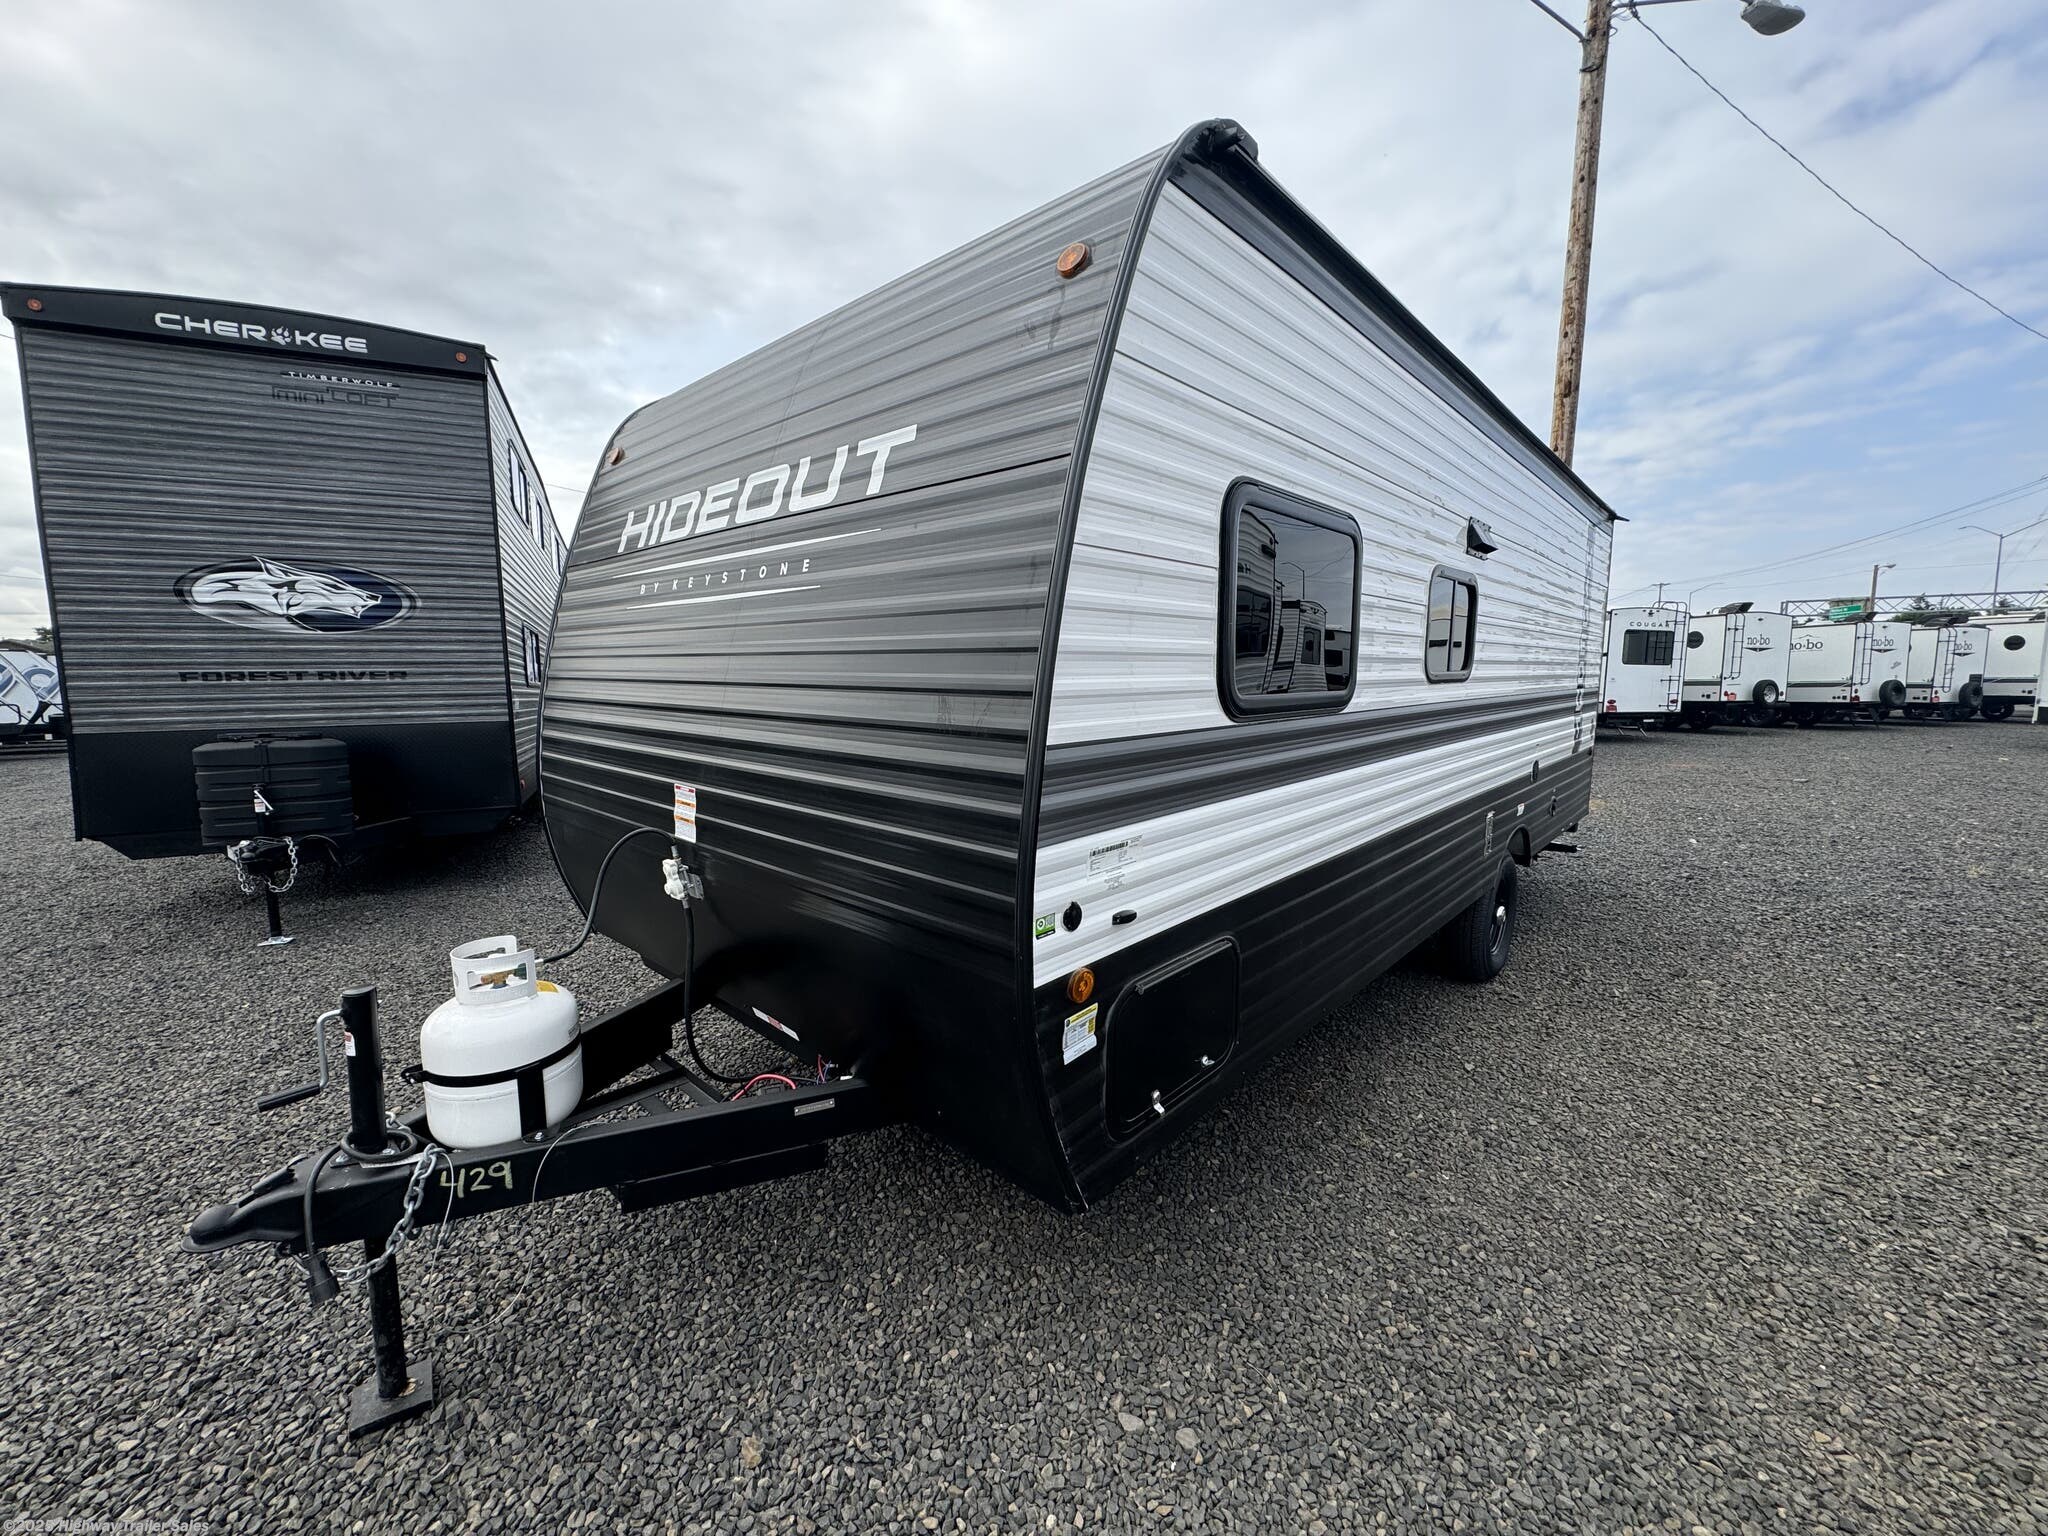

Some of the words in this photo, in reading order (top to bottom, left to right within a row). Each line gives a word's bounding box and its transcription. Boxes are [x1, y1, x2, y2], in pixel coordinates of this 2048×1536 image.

[288, 371, 394, 388] TIMBERWOLF
[617, 424, 917, 553] HIDEOUT
[640, 582, 659, 594] BY
[672, 559, 811, 591] KEYSTONE
[178, 670, 309, 682] FOREST
[317, 670, 408, 680] RIVER
[440, 1161, 513, 1198] 429
